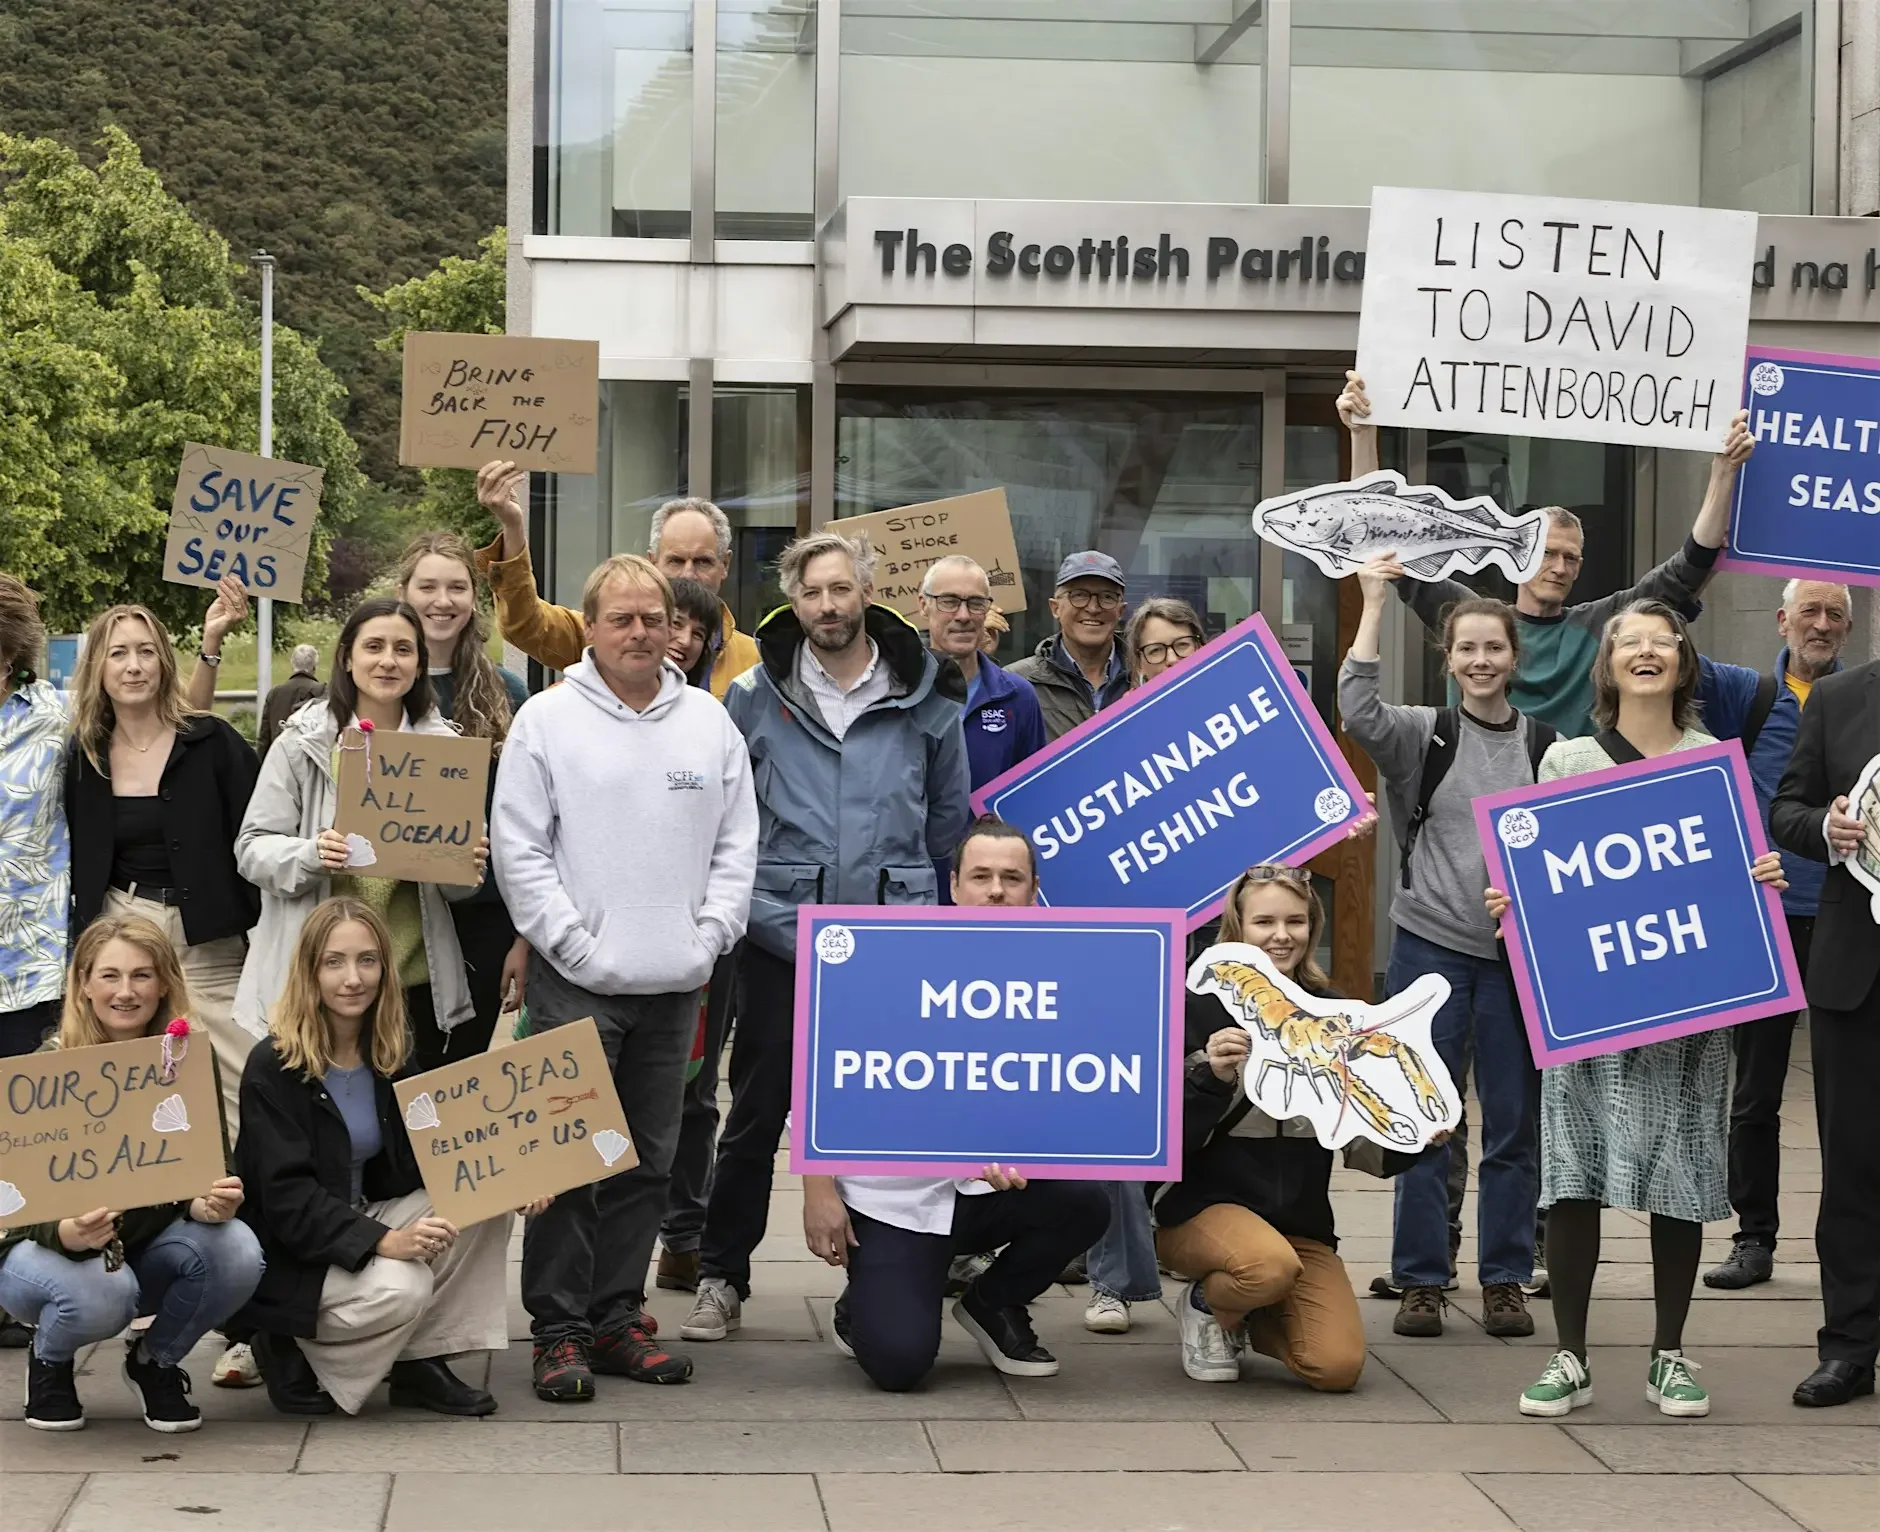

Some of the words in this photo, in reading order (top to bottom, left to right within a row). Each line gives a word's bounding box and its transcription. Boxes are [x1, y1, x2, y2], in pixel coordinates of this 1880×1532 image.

[875, 229, 972, 275] The
[986, 231, 1190, 279] Scottish
[1433, 217, 1665, 281] LISTEN
[1793, 261, 1848, 290] na
[1416, 286, 1492, 341] TO
[1524, 290, 1695, 358] DAVID
[443, 359, 536, 388] BRING
[1755, 373, 1779, 383] SEAS
[1758, 365, 1778, 374] OUR
[421, 392, 488, 416] BACK
[512, 396, 546, 408] THE
[1402, 356, 1716, 431] ATTENBOROGH
[470, 418, 558, 452] FISH
[1754, 409, 1880, 454] HEALT
[190, 470, 302, 526] SAVE
[1788, 473, 1880, 515] SEAS
[216, 518, 269, 543] our
[885, 513, 949, 532] STOP
[900, 534, 959, 551] SHORE
[177, 537, 278, 588] SEAS
[885, 555, 946, 575] BOTT
[981, 709, 1006, 719] BSAC
[379, 751, 427, 778] WE
[440, 766, 470, 780] are
[1032, 686, 1280, 860] SUSTAINABLE
[360, 788, 426, 813] ALL
[1318, 790, 1337, 805] OUR
[1320, 795, 1344, 814] SEAS
[380, 820, 472, 847] OCEAN
[1107, 771, 1261, 885] FISHING
[1505, 811, 1527, 824] OUR
[1505, 820, 1532, 835] SEAS
[1542, 815, 1713, 895] MORE
[822, 938, 849, 948] SEAS
[825, 928, 847, 938] OUR
[1588, 903, 1709, 973] FISH
[920, 979, 1059, 1021] MORE
[8, 1070, 84, 1114] OUR
[85, 1061, 178, 1118] SEAS
[434, 1076, 480, 1104] OUR
[483, 1050, 580, 1112] SEAS
[834, 1050, 1142, 1095] PROTECTION
[0, 1128, 69, 1155] BELONG
[83, 1121, 107, 1135] TO
[431, 1122, 500, 1156] BELONG
[507, 1109, 538, 1129] TO
[49, 1148, 99, 1182] US
[107, 1134, 183, 1174] ALL
[454, 1155, 505, 1192] ALL
[518, 1139, 540, 1156] OF
[553, 1118, 588, 1145] US
